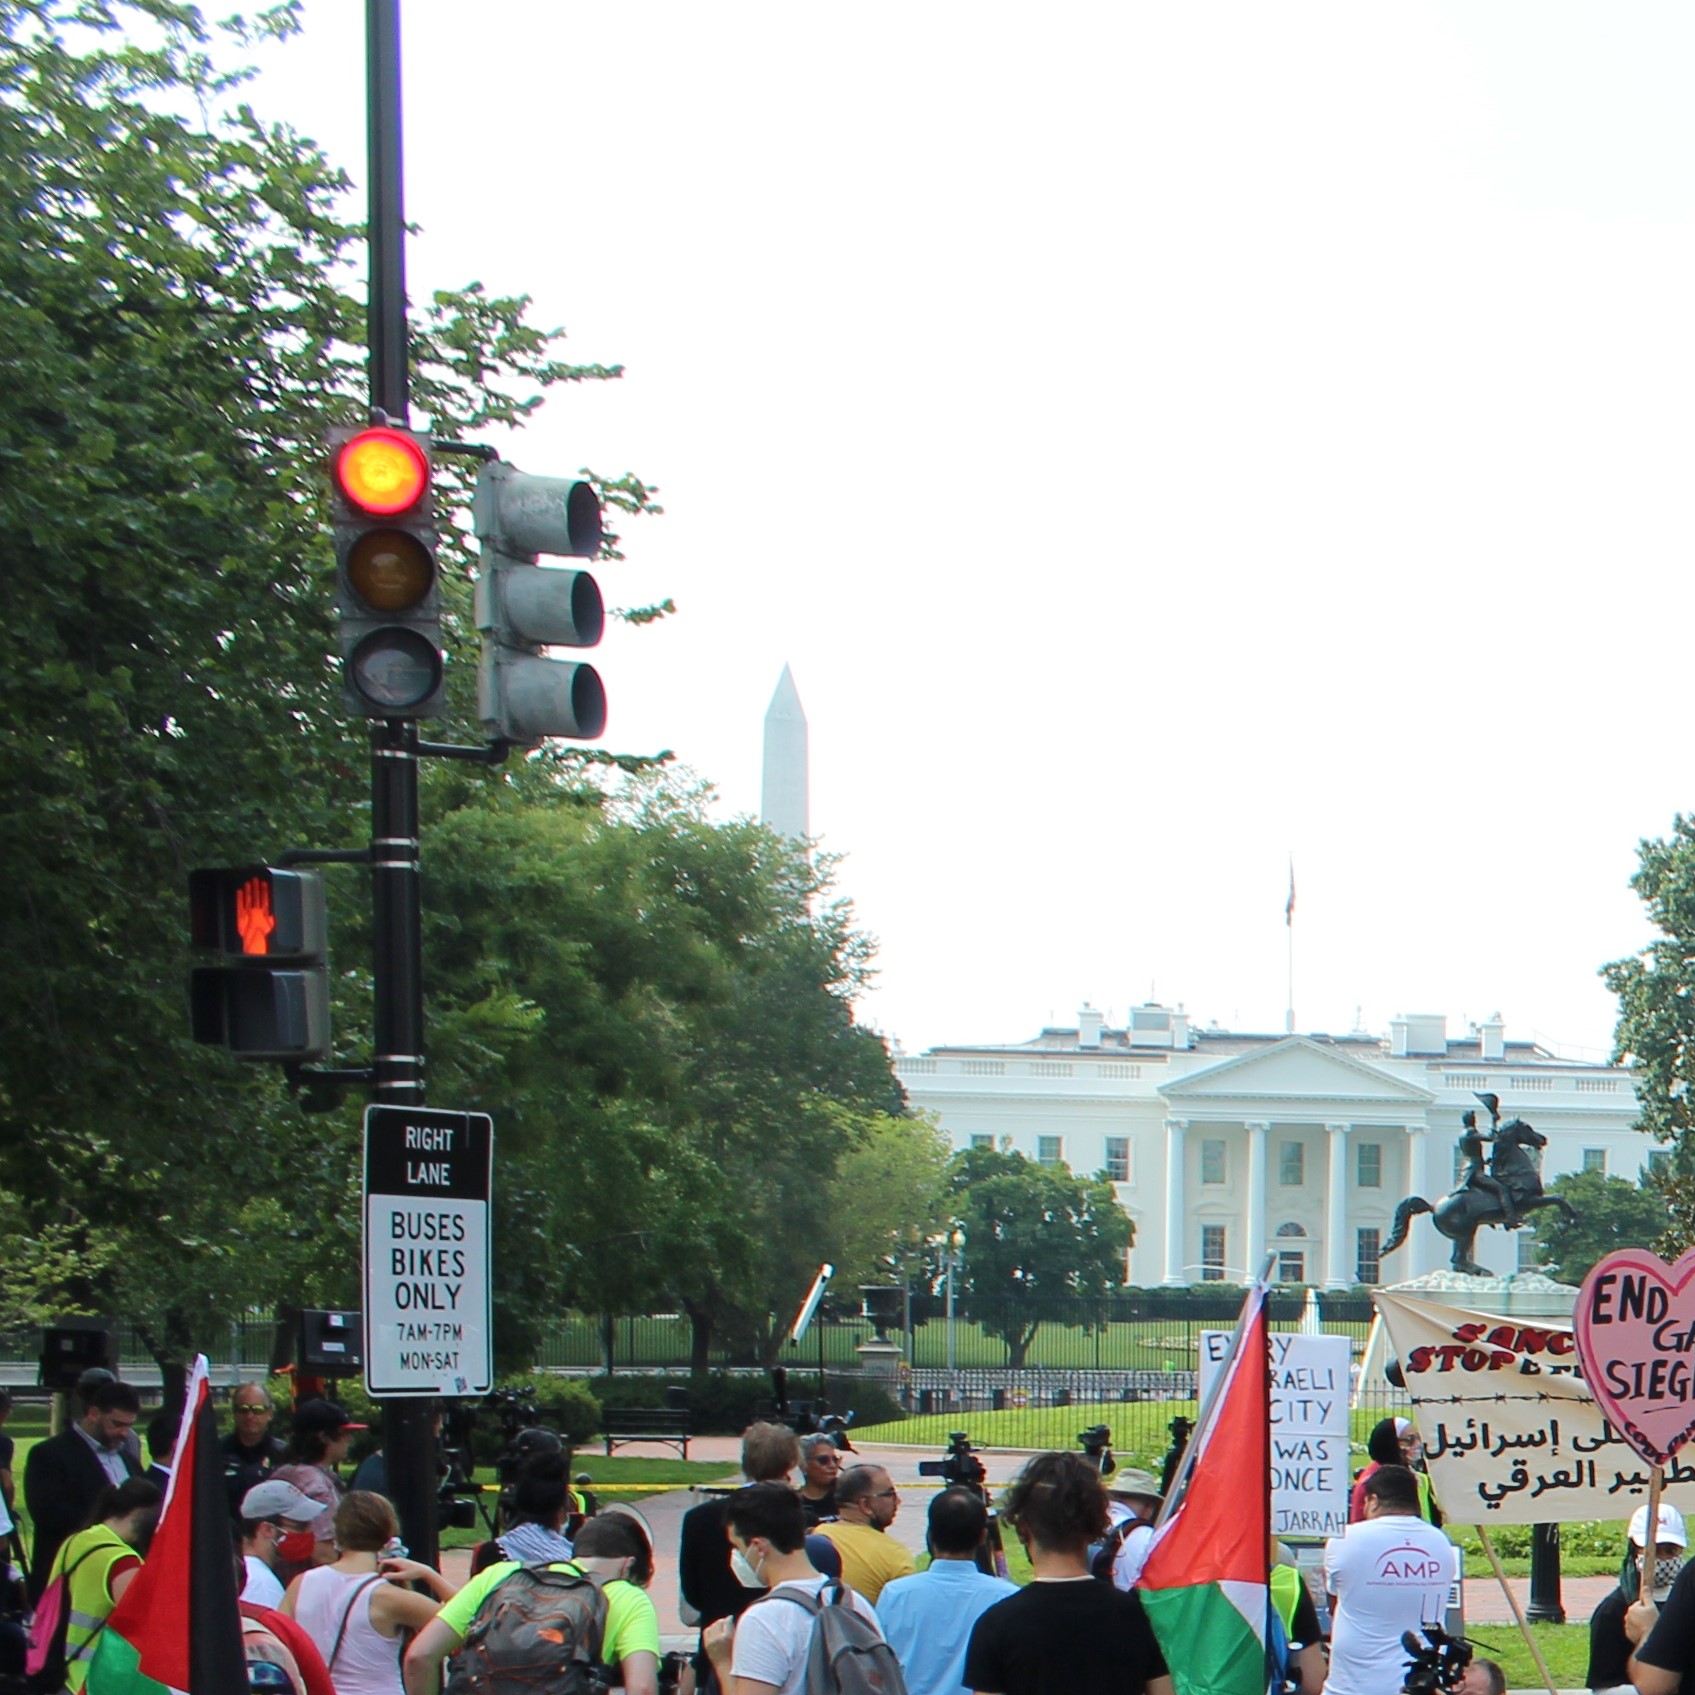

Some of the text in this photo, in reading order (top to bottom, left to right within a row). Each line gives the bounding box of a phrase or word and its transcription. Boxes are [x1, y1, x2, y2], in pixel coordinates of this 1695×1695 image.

[405, 1126, 454, 1151] RIGHT
[407, 1162, 451, 1186] LANE
[391, 1211, 465, 1241] BUSES
[391, 1249, 465, 1277] BIKES
[395, 1282, 463, 1310] ONLY
[1592, 1274, 1669, 1325] END
[397, 1323, 463, 1341] 7AM-7PM
[1452, 1323, 1575, 1356] SANC
[400, 1352, 460, 1370] MON-SAT
[1207, 1334, 1293, 1366] ERY
[1406, 1345, 1516, 1373] STOP
[1269, 1367, 1334, 1391] RAELI
[1269, 1399, 1332, 1425] CITY
[1424, 1418, 1558, 1460] إسرائيل
[1572, 1418, 1625, 1452] لى
[1274, 1440, 1329, 1461] WAS
[1269, 1467, 1333, 1493] ONCE
[1478, 1459, 1597, 1509] العرقي
[1276, 1509, 1346, 1534] JARRAH
[1381, 1561, 1441, 1578] AMP
